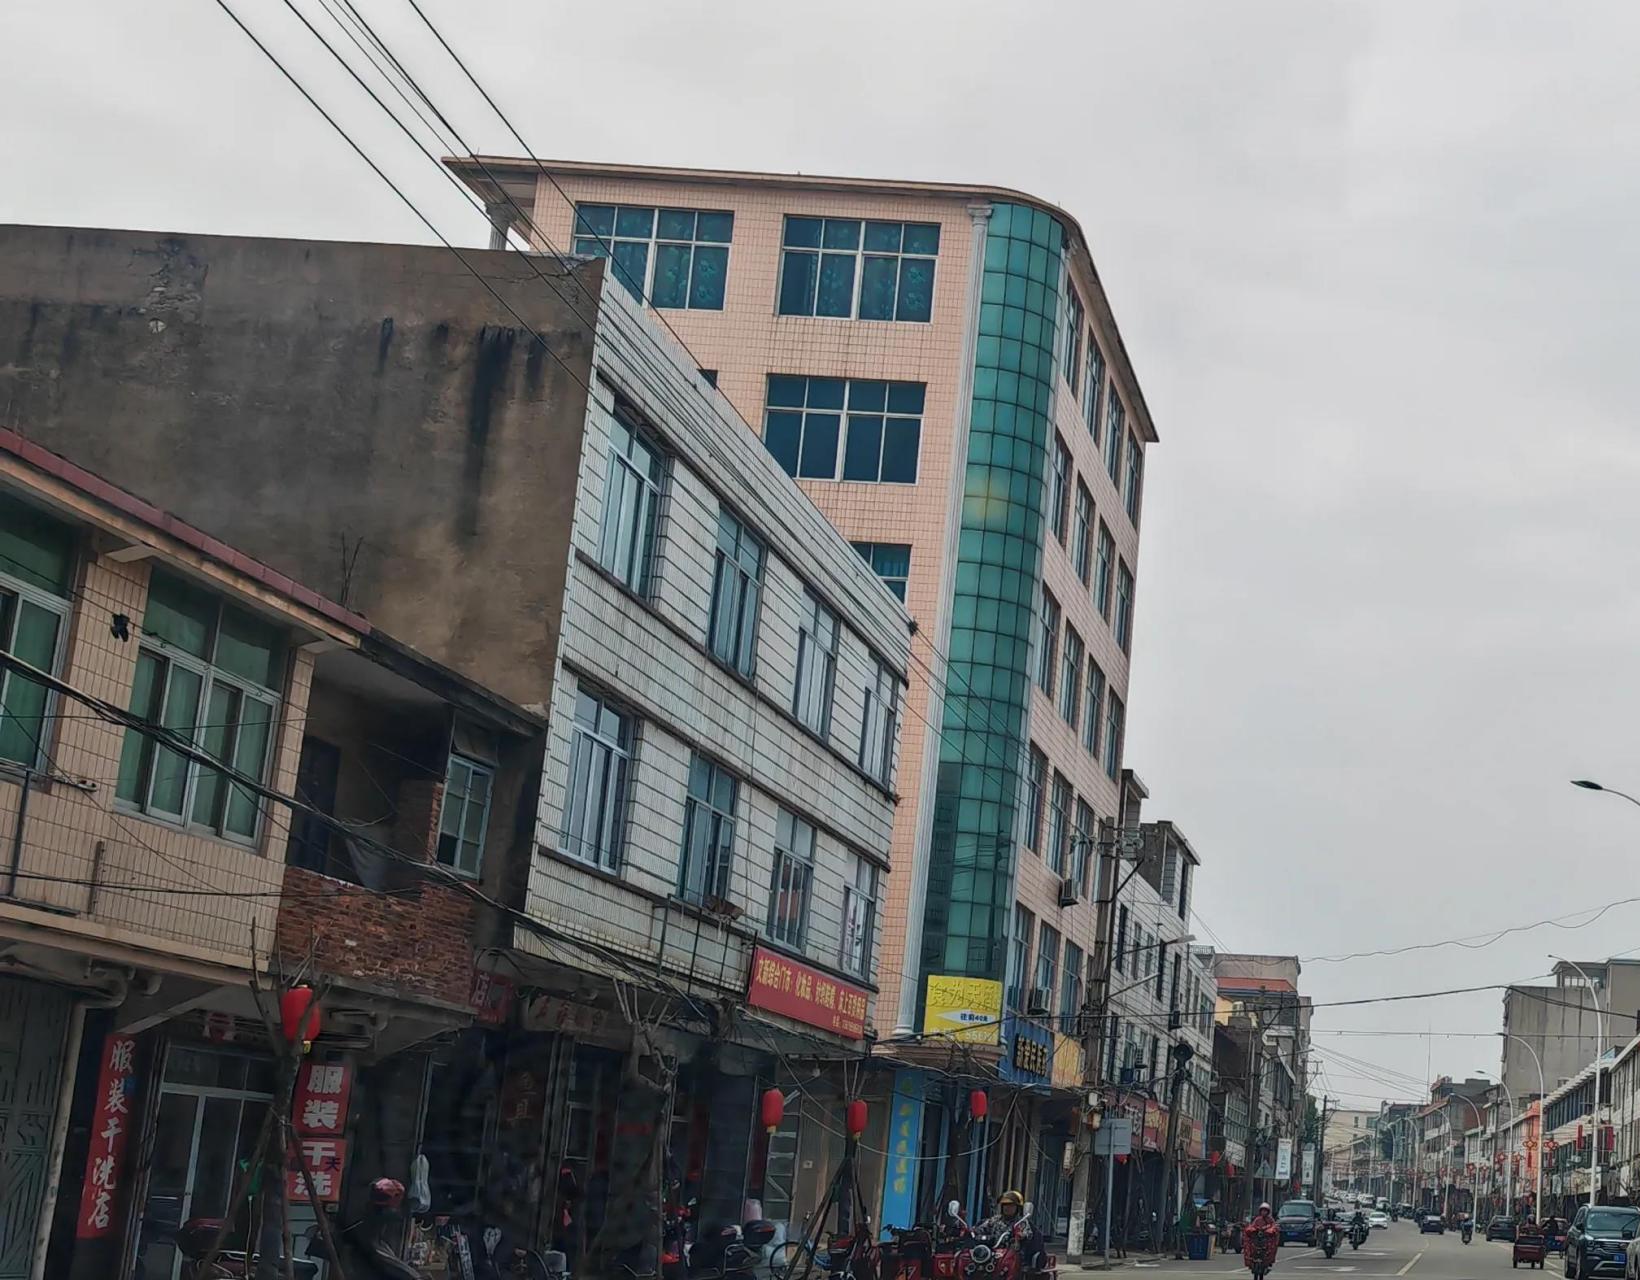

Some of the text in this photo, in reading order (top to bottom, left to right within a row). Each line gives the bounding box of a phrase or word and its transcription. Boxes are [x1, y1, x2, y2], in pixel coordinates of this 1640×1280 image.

[302, 1063, 346, 1130] 服装
[86, 1039, 136, 1230] 服装干洗店
[294, 1140, 337, 1197] 干洗
